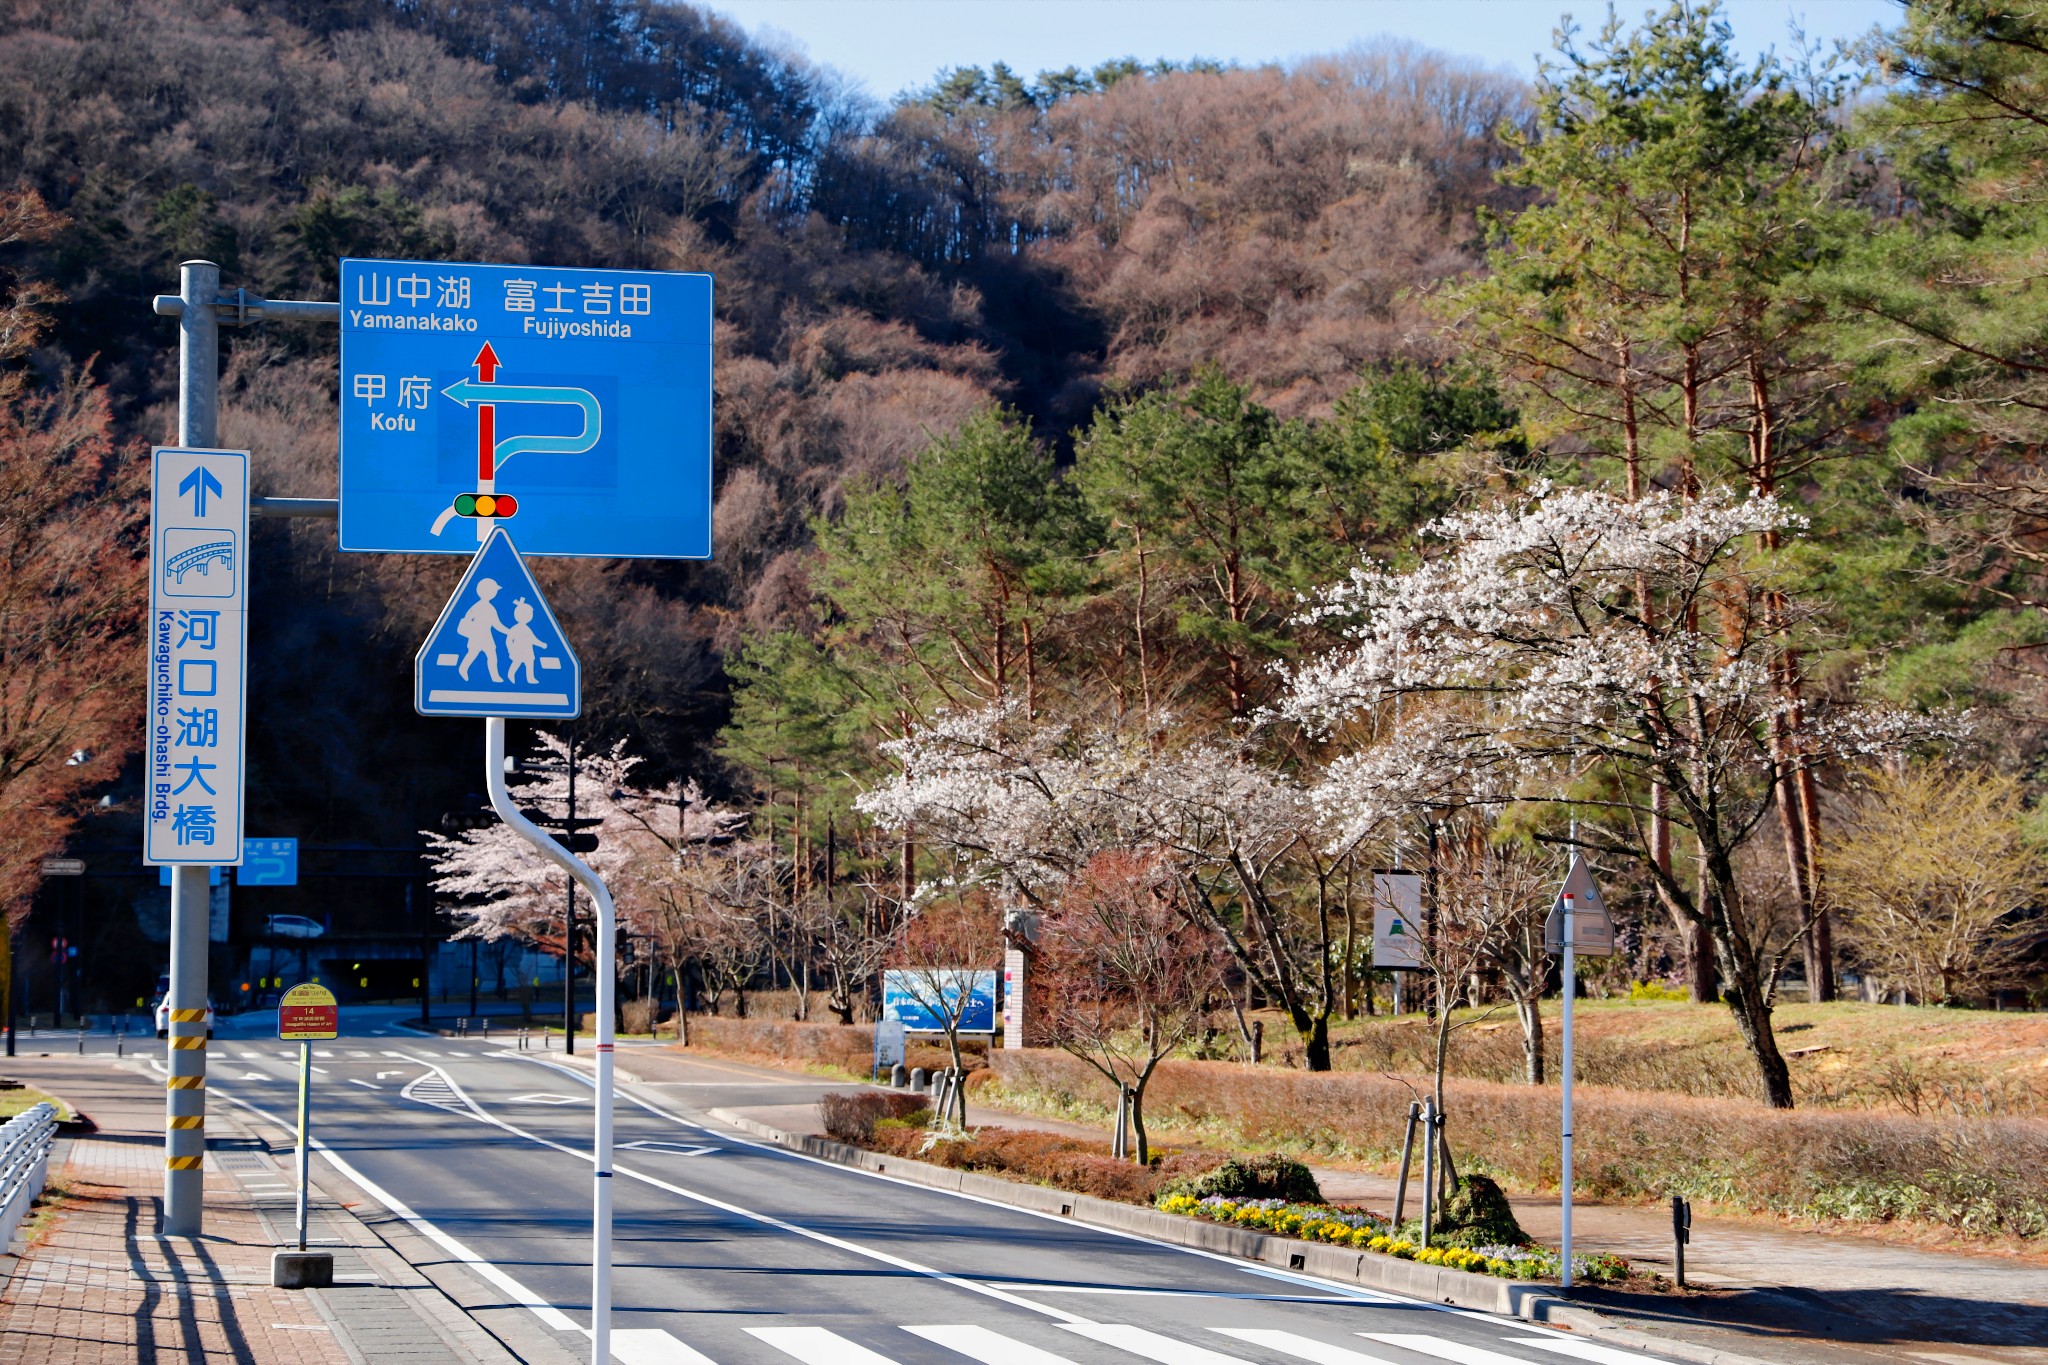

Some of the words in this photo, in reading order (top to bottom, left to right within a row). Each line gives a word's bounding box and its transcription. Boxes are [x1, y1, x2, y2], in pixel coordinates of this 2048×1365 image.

[358, 272, 471, 309] 山中湖
[503, 278, 651, 315] 富士吉田
[349, 309, 478, 332] Yamanakako
[523, 316, 632, 339] Fujiyoshida
[353, 374, 432, 410] 甲府
[371, 412, 416, 432] Kofu
[155, 611, 175, 777] Kawaguchiko-ohashi
[172, 609, 221, 846] 河口湖大橋
[152, 783, 171, 824] Brdg.
[304, 1007, 314, 1015] 14
